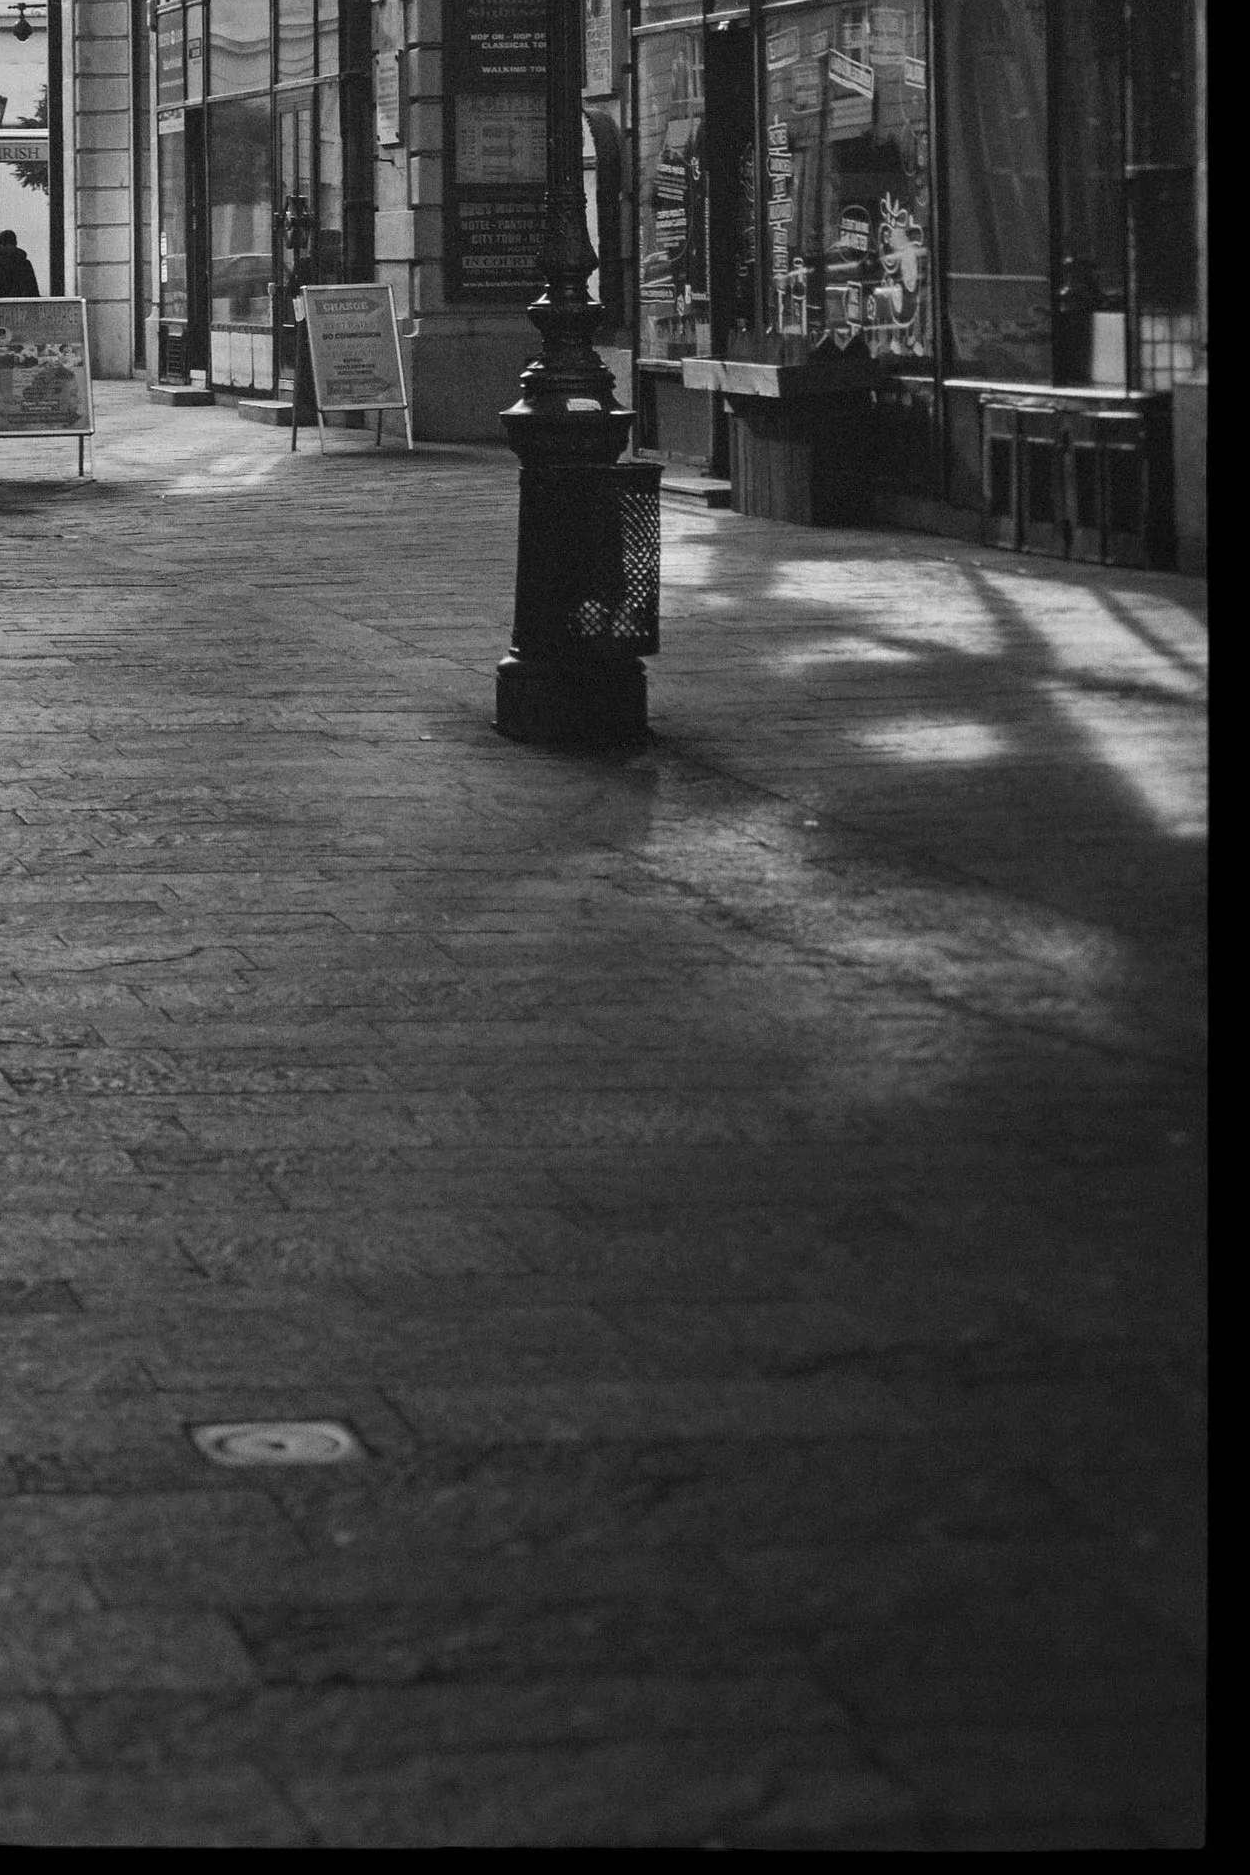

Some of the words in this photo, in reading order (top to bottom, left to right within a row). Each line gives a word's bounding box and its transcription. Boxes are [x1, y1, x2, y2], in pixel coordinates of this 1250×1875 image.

[323, 301, 369, 311] CHANGE
[322, 333, 333, 341] NO
[335, 331, 382, 340] COMMISSION
